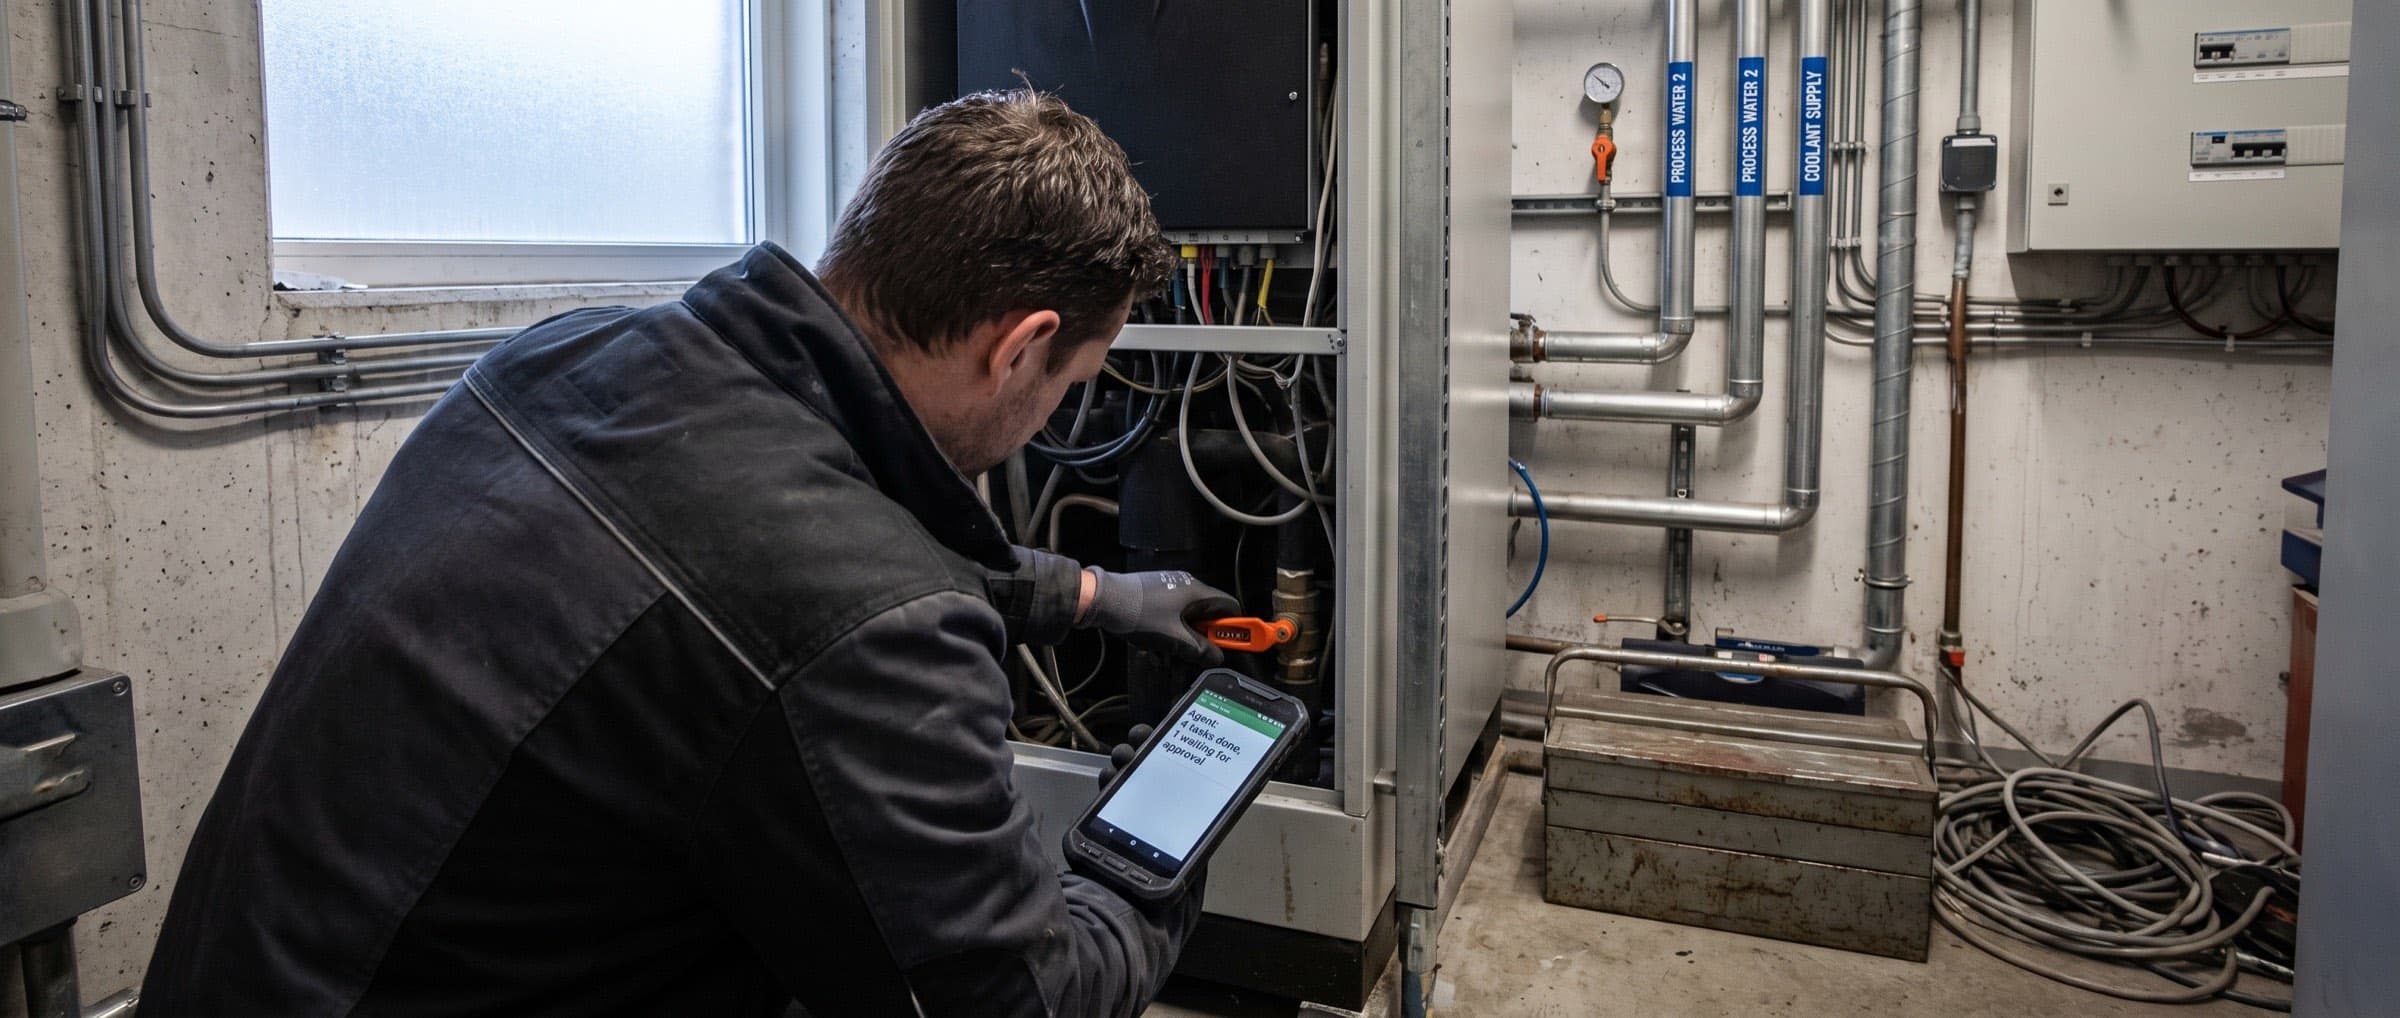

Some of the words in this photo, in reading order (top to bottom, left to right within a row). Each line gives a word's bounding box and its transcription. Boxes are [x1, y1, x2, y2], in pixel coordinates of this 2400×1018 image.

[1672, 73, 1687, 81] 2
[1744, 69, 1758, 78] 2
[1672, 85, 1686, 126] WATER
[1743, 81, 1758, 123] WATER
[1806, 71, 1822, 119] SUPPLY
[1671, 129, 1685, 183] PROCESS
[1742, 127, 1757, 182] PROCESS
[1804, 122, 1821, 182] COOLANT
[1181, 720, 1189, 728] 4
[1189, 724, 1215, 741] tasks
[1215, 737, 1241, 755] done,
[1188, 709, 1219, 728] Agent:
[1162, 741, 1207, 766] approval
[1173, 730, 1180, 738] 1
[1180, 734, 1216, 757] waiting
[1215, 751, 1232, 763] for
